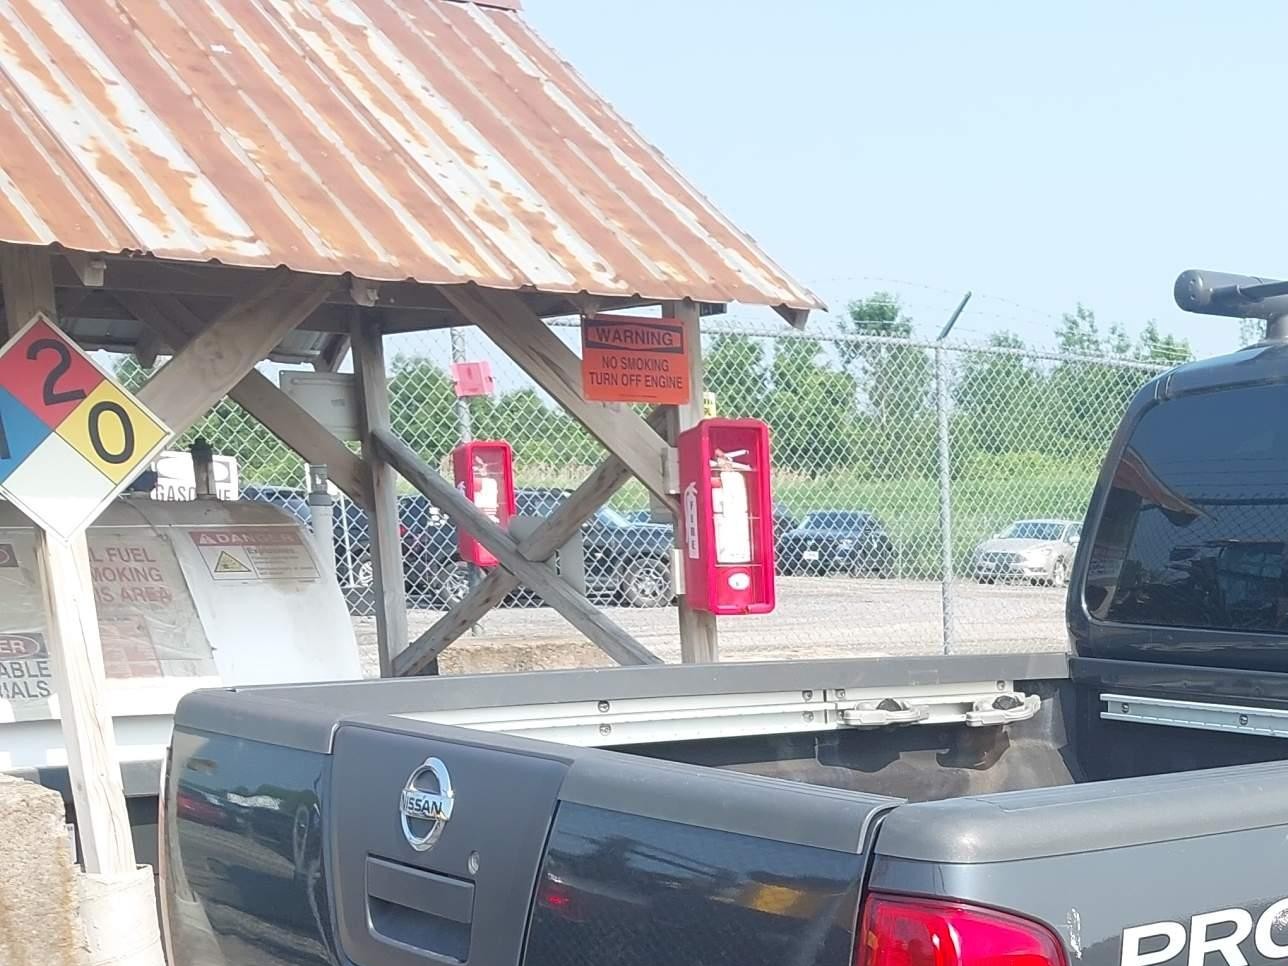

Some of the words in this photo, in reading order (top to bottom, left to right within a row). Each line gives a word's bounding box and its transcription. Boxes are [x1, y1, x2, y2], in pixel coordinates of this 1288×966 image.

[596, 327, 673, 347] WARNING
[26, 338, 86, 406] 2
[602, 356, 618, 370] NO
[621, 358, 669, 372] SMOKING
[589, 371, 618, 387] TURN
[620, 373, 642, 388] OFF
[644, 375, 682, 389] ENGINE
[88, 401, 135, 464] 0
[107, 547, 157, 562] FUEL
[92, 567, 164, 583] MOKING
[120, 587, 173, 604] AREA
